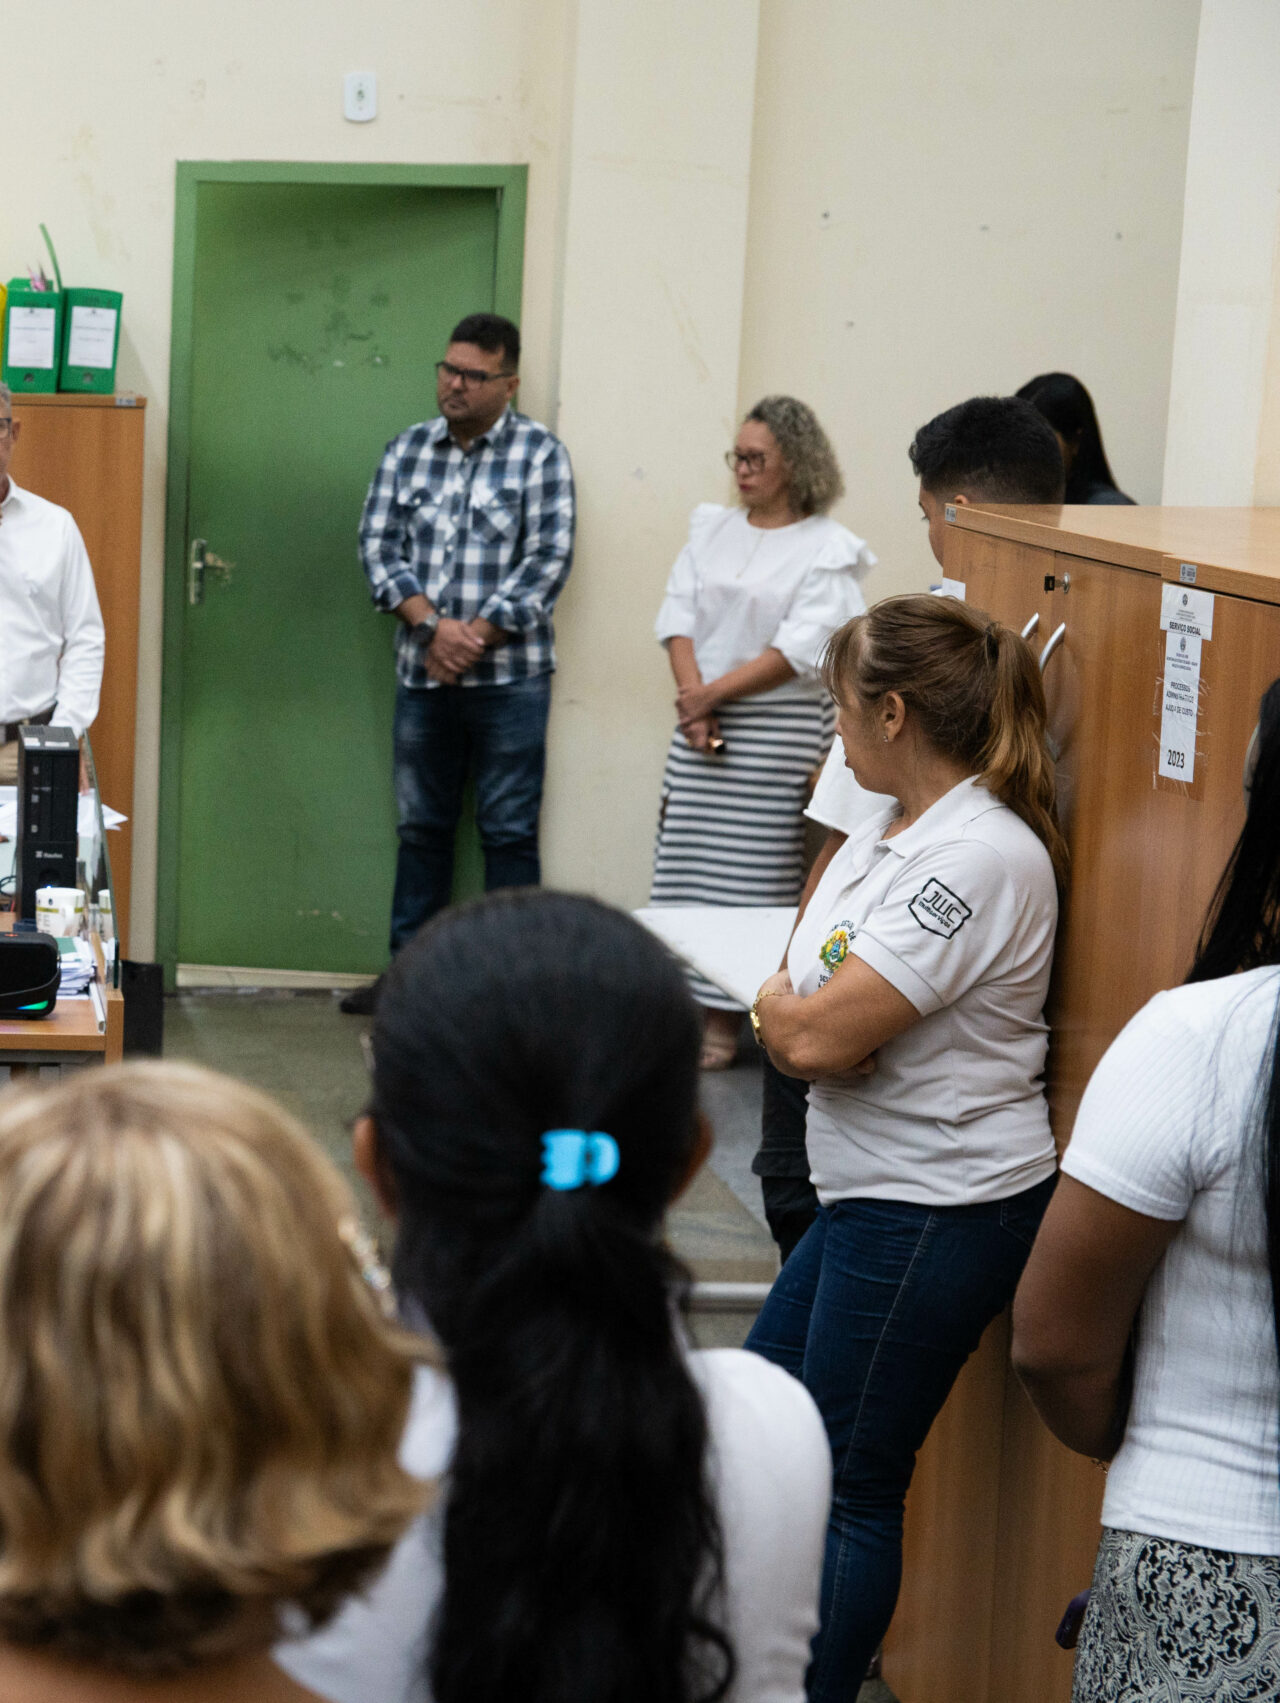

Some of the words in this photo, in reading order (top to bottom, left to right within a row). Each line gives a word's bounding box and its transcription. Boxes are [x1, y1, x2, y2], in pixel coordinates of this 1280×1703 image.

[1186, 624, 1202, 636] SOCIAL
[1167, 749, 1185, 769] 2023
[923, 890, 962, 924] JWC
